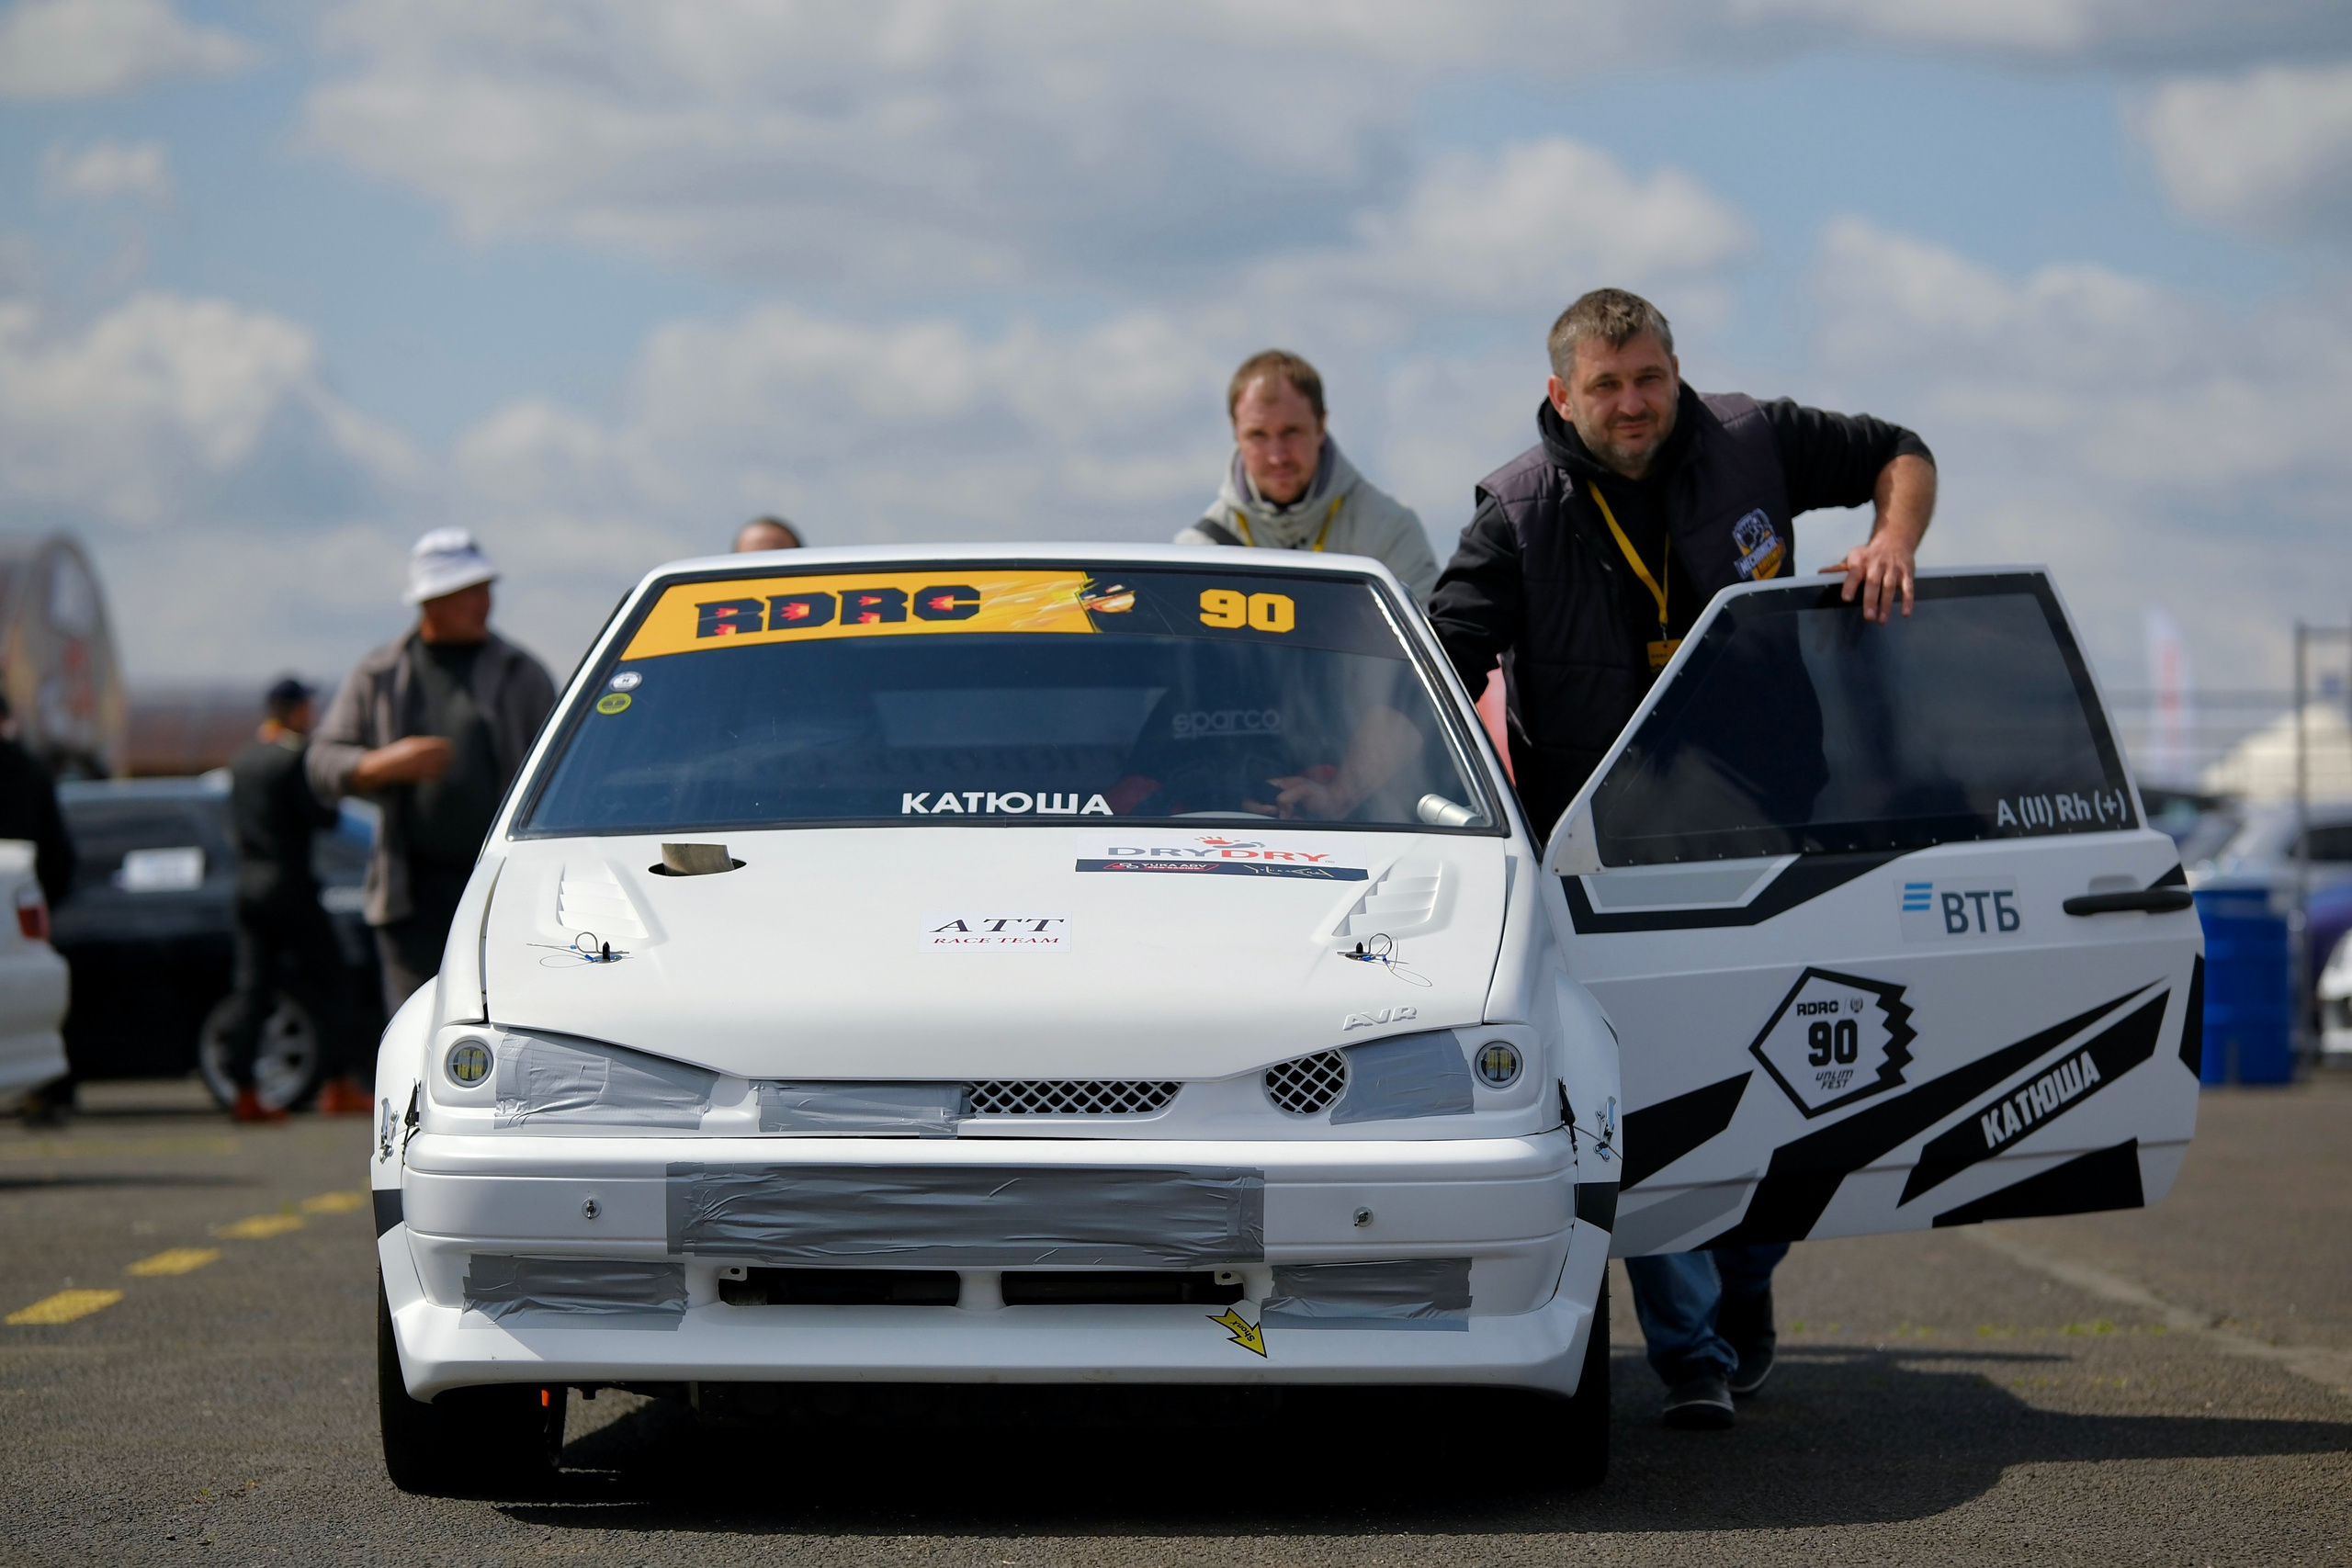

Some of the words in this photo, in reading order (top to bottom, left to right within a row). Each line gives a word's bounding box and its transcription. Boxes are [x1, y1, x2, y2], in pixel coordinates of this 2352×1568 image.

[695, 584, 980, 638] RDRC
[1200, 588, 1295, 634] 90
[1172, 709, 1280, 739] sparco
[901, 791, 1114, 816] КАТЮША
[1997, 798, 2018, 827] A
[2055, 792, 2092, 822] Rh
[2094, 787, 2127, 823] (+)
[1107, 847, 1330, 863] DRYDRY
[928, 918, 1066, 933] ATT
[1940, 890, 2020, 933] ВТБ
[1796, 999, 1839, 1016] RDRC
[1808, 1019, 1858, 1066] 90
[1821, 1078, 1850, 1090] FEST
[1981, 1050, 2101, 1150] КАТЮША
